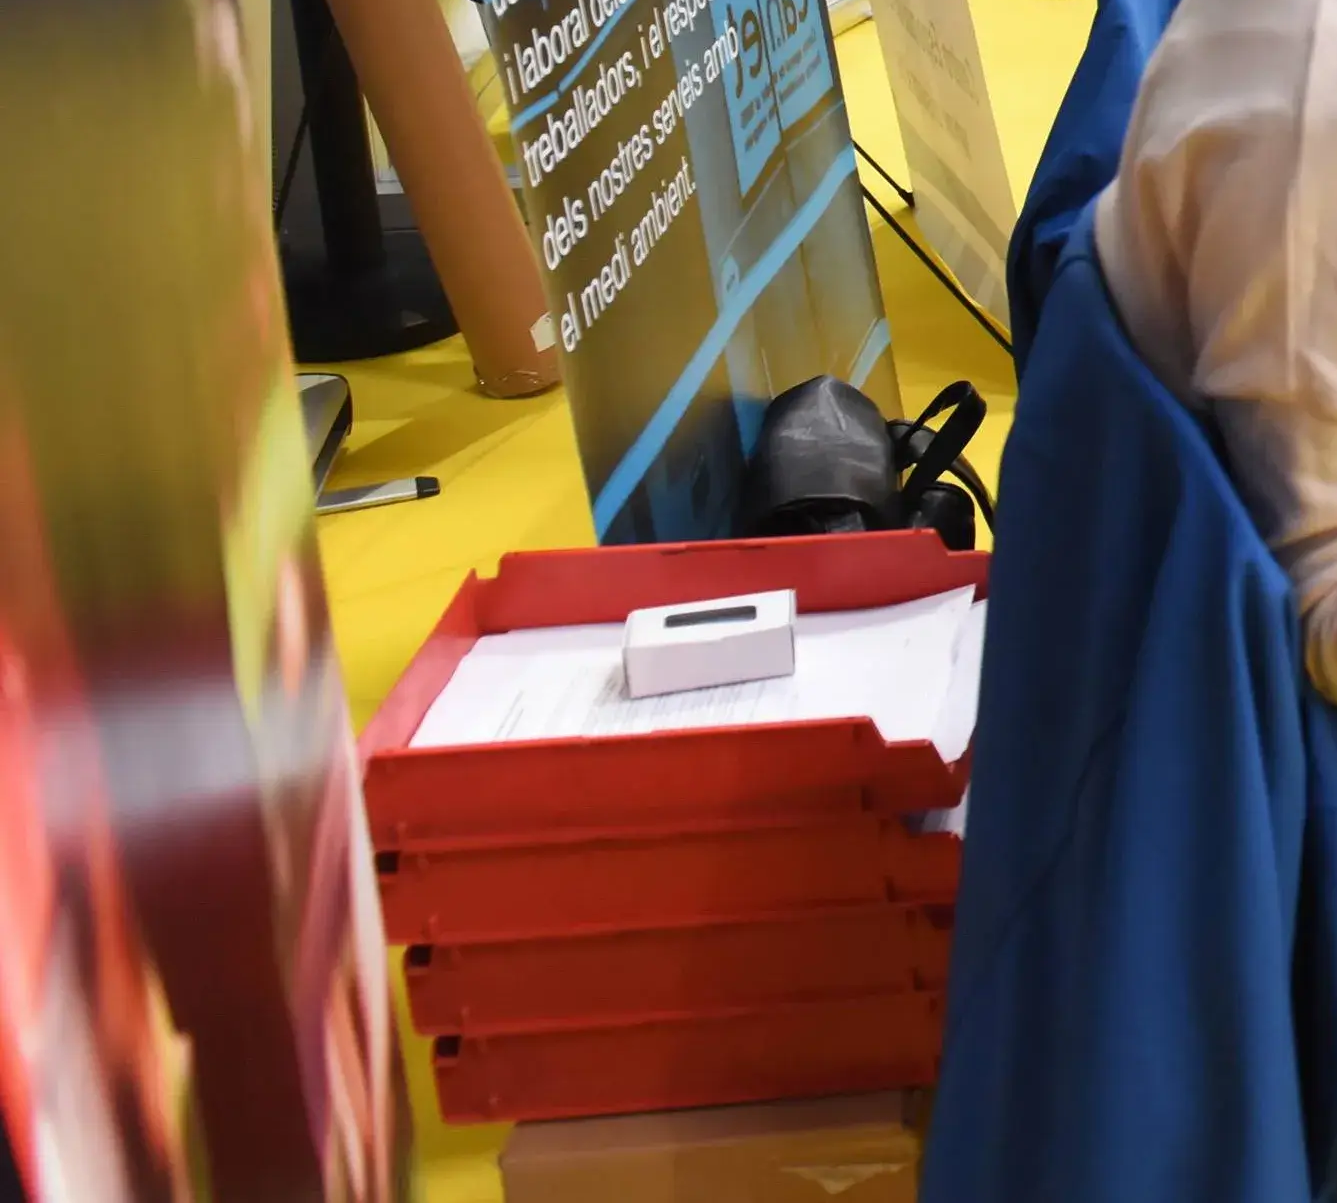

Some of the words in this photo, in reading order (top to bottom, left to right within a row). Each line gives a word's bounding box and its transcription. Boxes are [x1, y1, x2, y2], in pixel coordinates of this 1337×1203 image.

[504, 52, 519, 105] i
[522, 51, 642, 188] treballadors,
[638, 24, 650, 70] i
[649, 7, 665, 59] el
[543, 197, 588, 271] dels
[588, 124, 654, 221] nostres
[652, 59, 704, 144] serveis
[704, 20, 740, 84] amb
[560, 292, 582, 352] el
[581, 231, 632, 328] medi
[631, 156, 697, 266] ambient.
